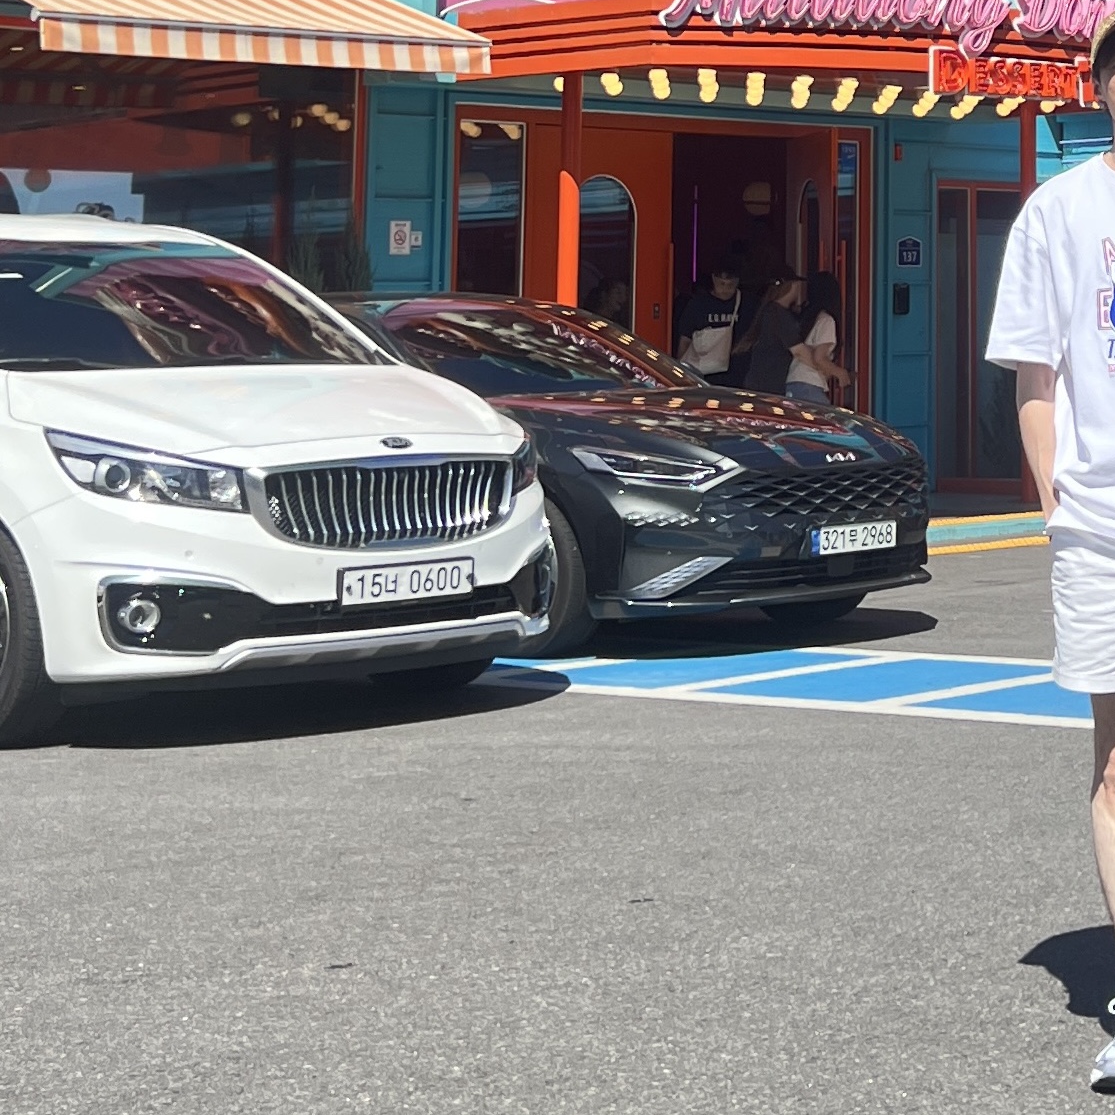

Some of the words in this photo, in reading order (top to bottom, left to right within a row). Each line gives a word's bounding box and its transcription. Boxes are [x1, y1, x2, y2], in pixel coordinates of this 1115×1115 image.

[929, 45, 1079, 98] DESSERT
[902, 251, 918, 263] 137
[861, 524, 893, 547] 2968
[357, 572, 399, 599] 15너
[410, 566, 461, 594] 0600
